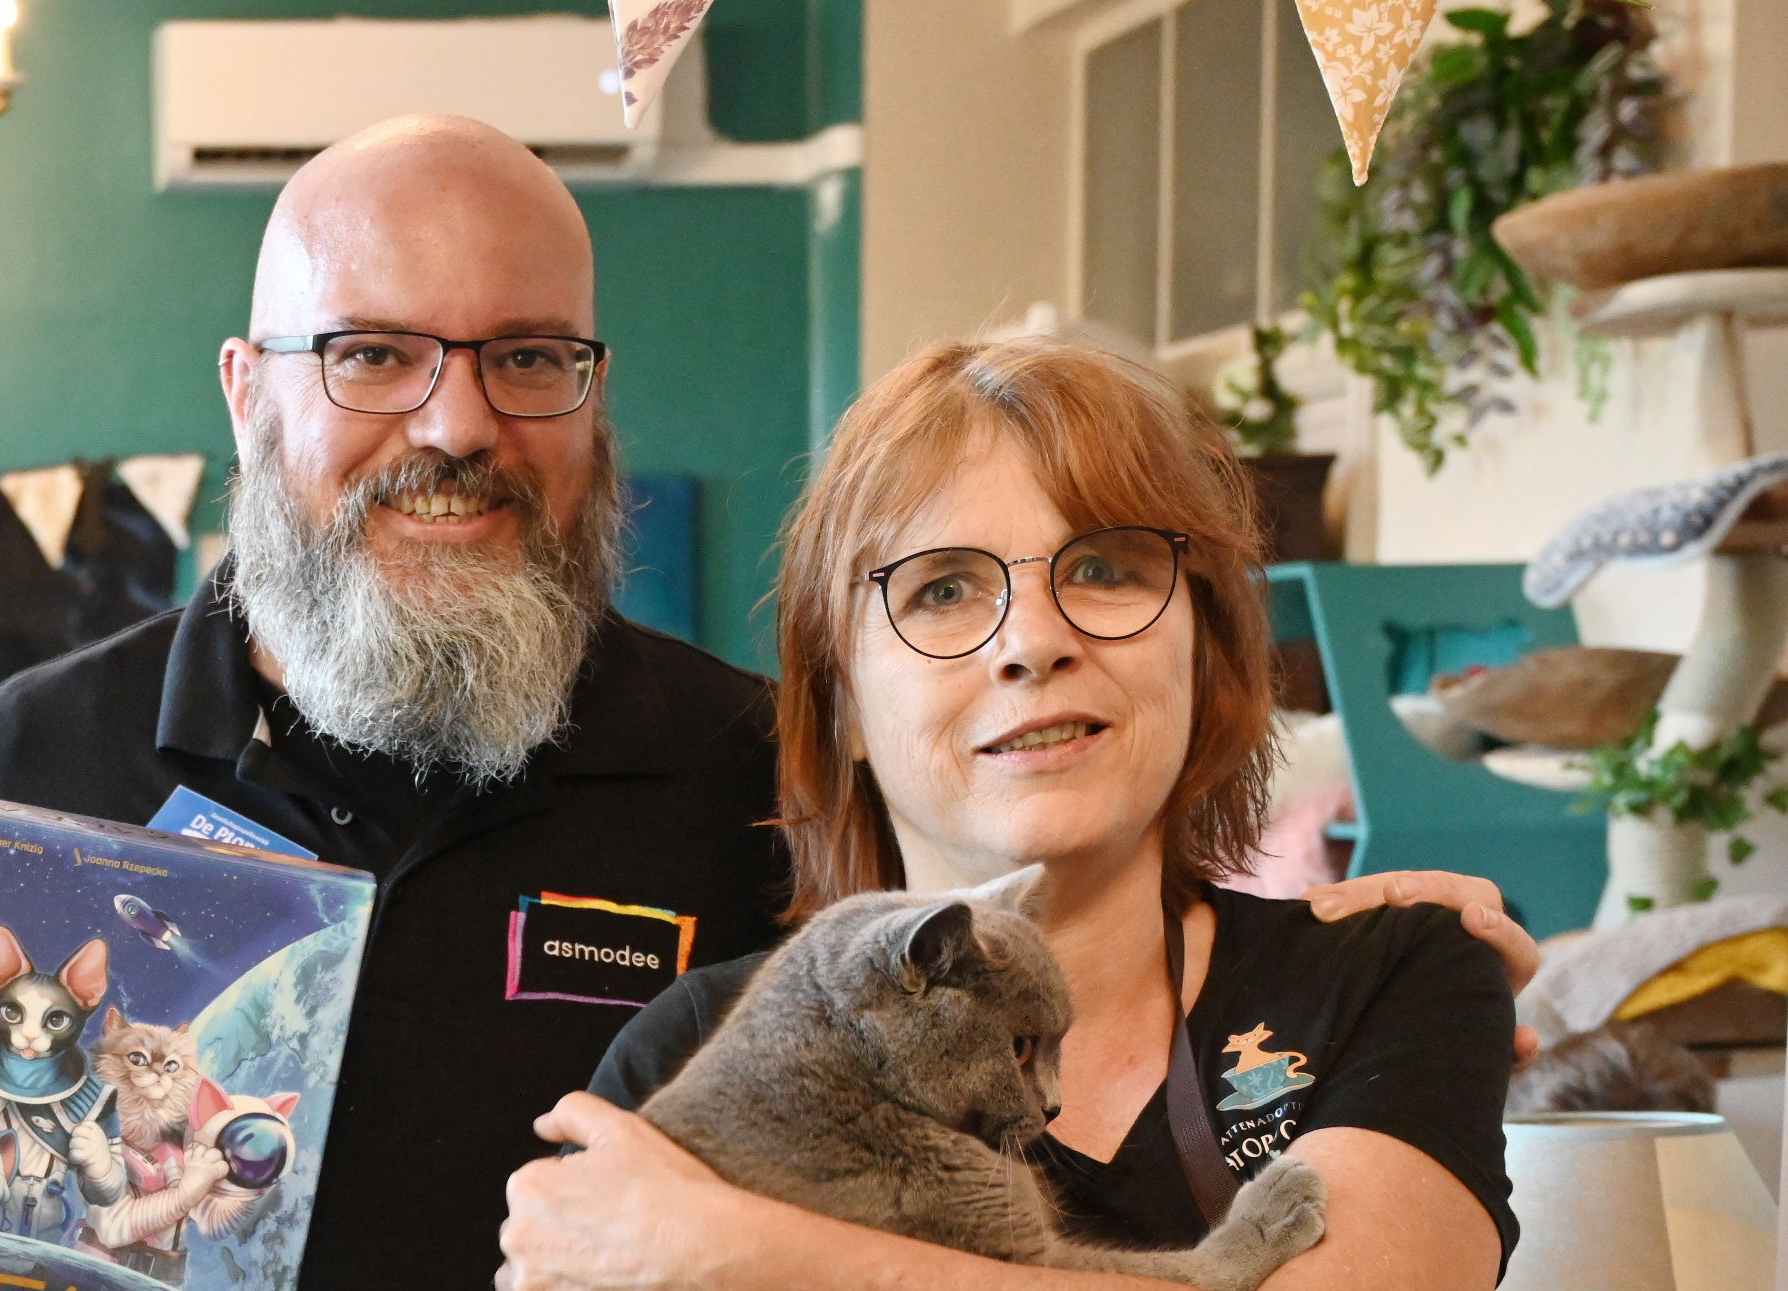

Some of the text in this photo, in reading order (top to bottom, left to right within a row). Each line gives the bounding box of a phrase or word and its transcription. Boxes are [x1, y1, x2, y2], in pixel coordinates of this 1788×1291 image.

[189, 814, 214, 835] De
[13, 840, 44, 855] Knizia
[83, 854, 169, 877] Joanna Rzepecka
[543, 939, 660, 969] asmodee
[1220, 1101, 1302, 1146] ATTENADOPTI
